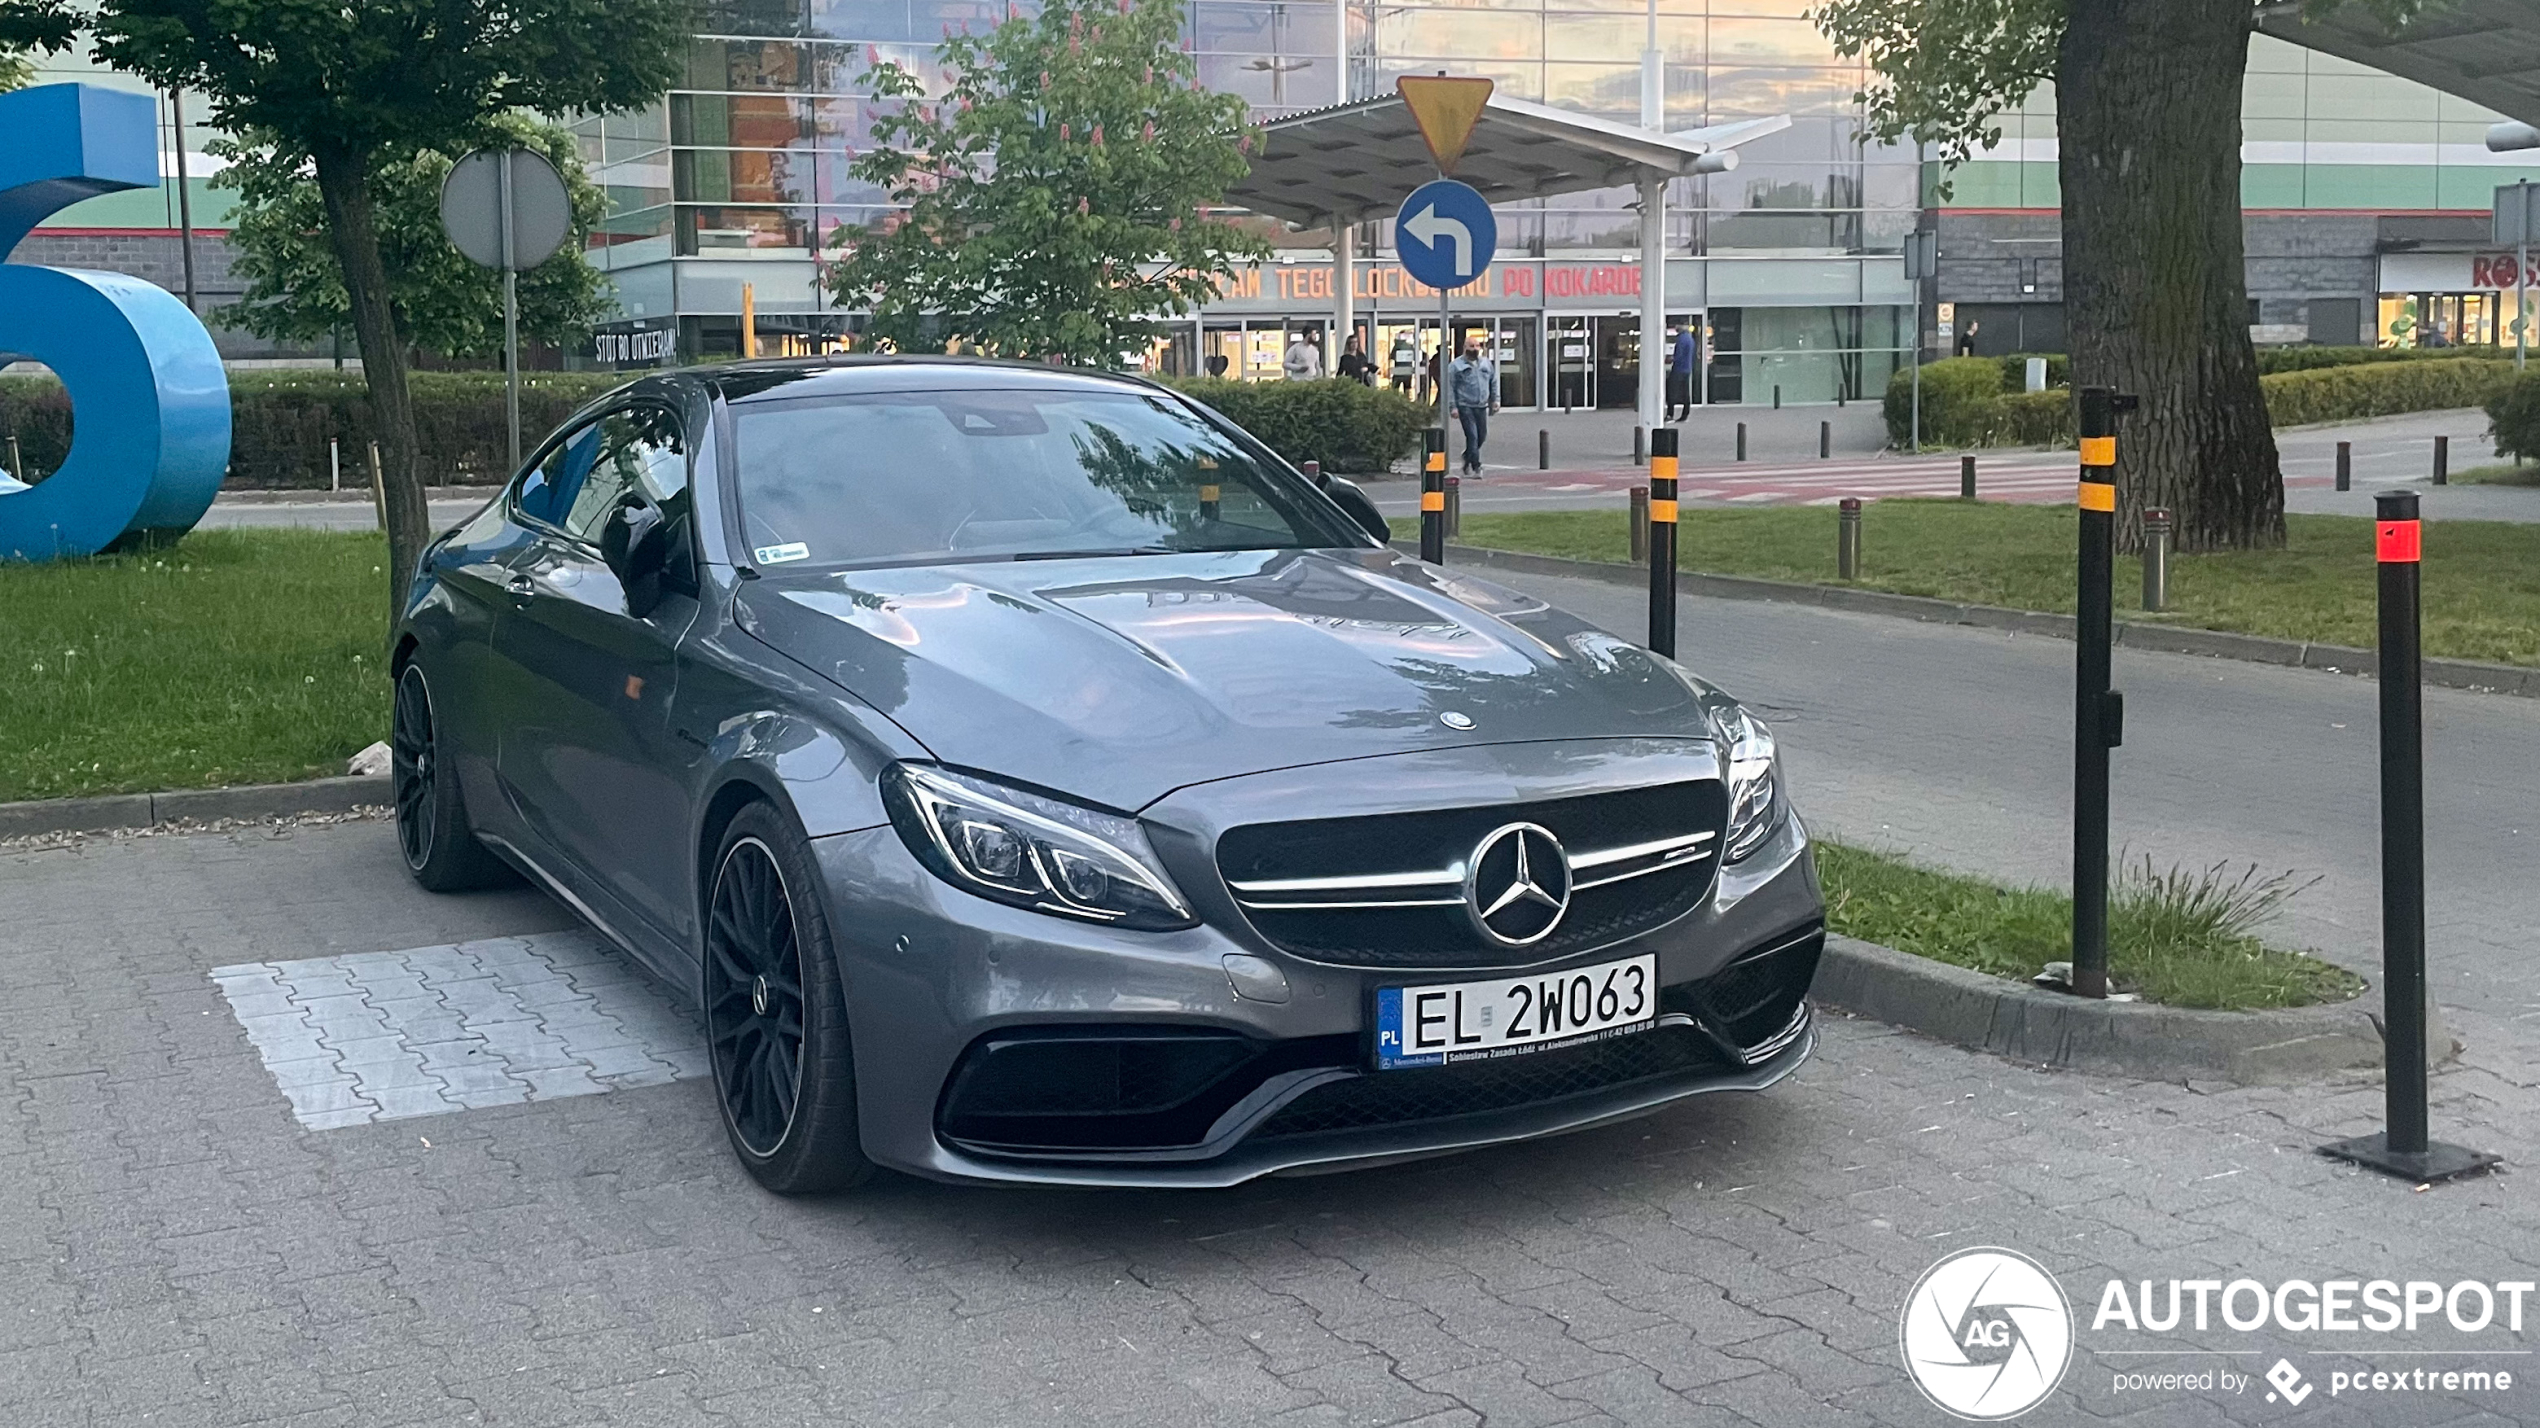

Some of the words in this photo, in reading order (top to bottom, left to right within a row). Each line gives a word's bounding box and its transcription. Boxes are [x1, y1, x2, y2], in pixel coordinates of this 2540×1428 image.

[1503, 267, 1533, 297] PO
[2473, 256, 2540, 289] ROS
[618, 334, 629, 361] BO
[1416, 991, 1481, 1049] EL
[1506, 964, 1645, 1039] 2W063
[1381, 1031, 1399, 1046] PL
